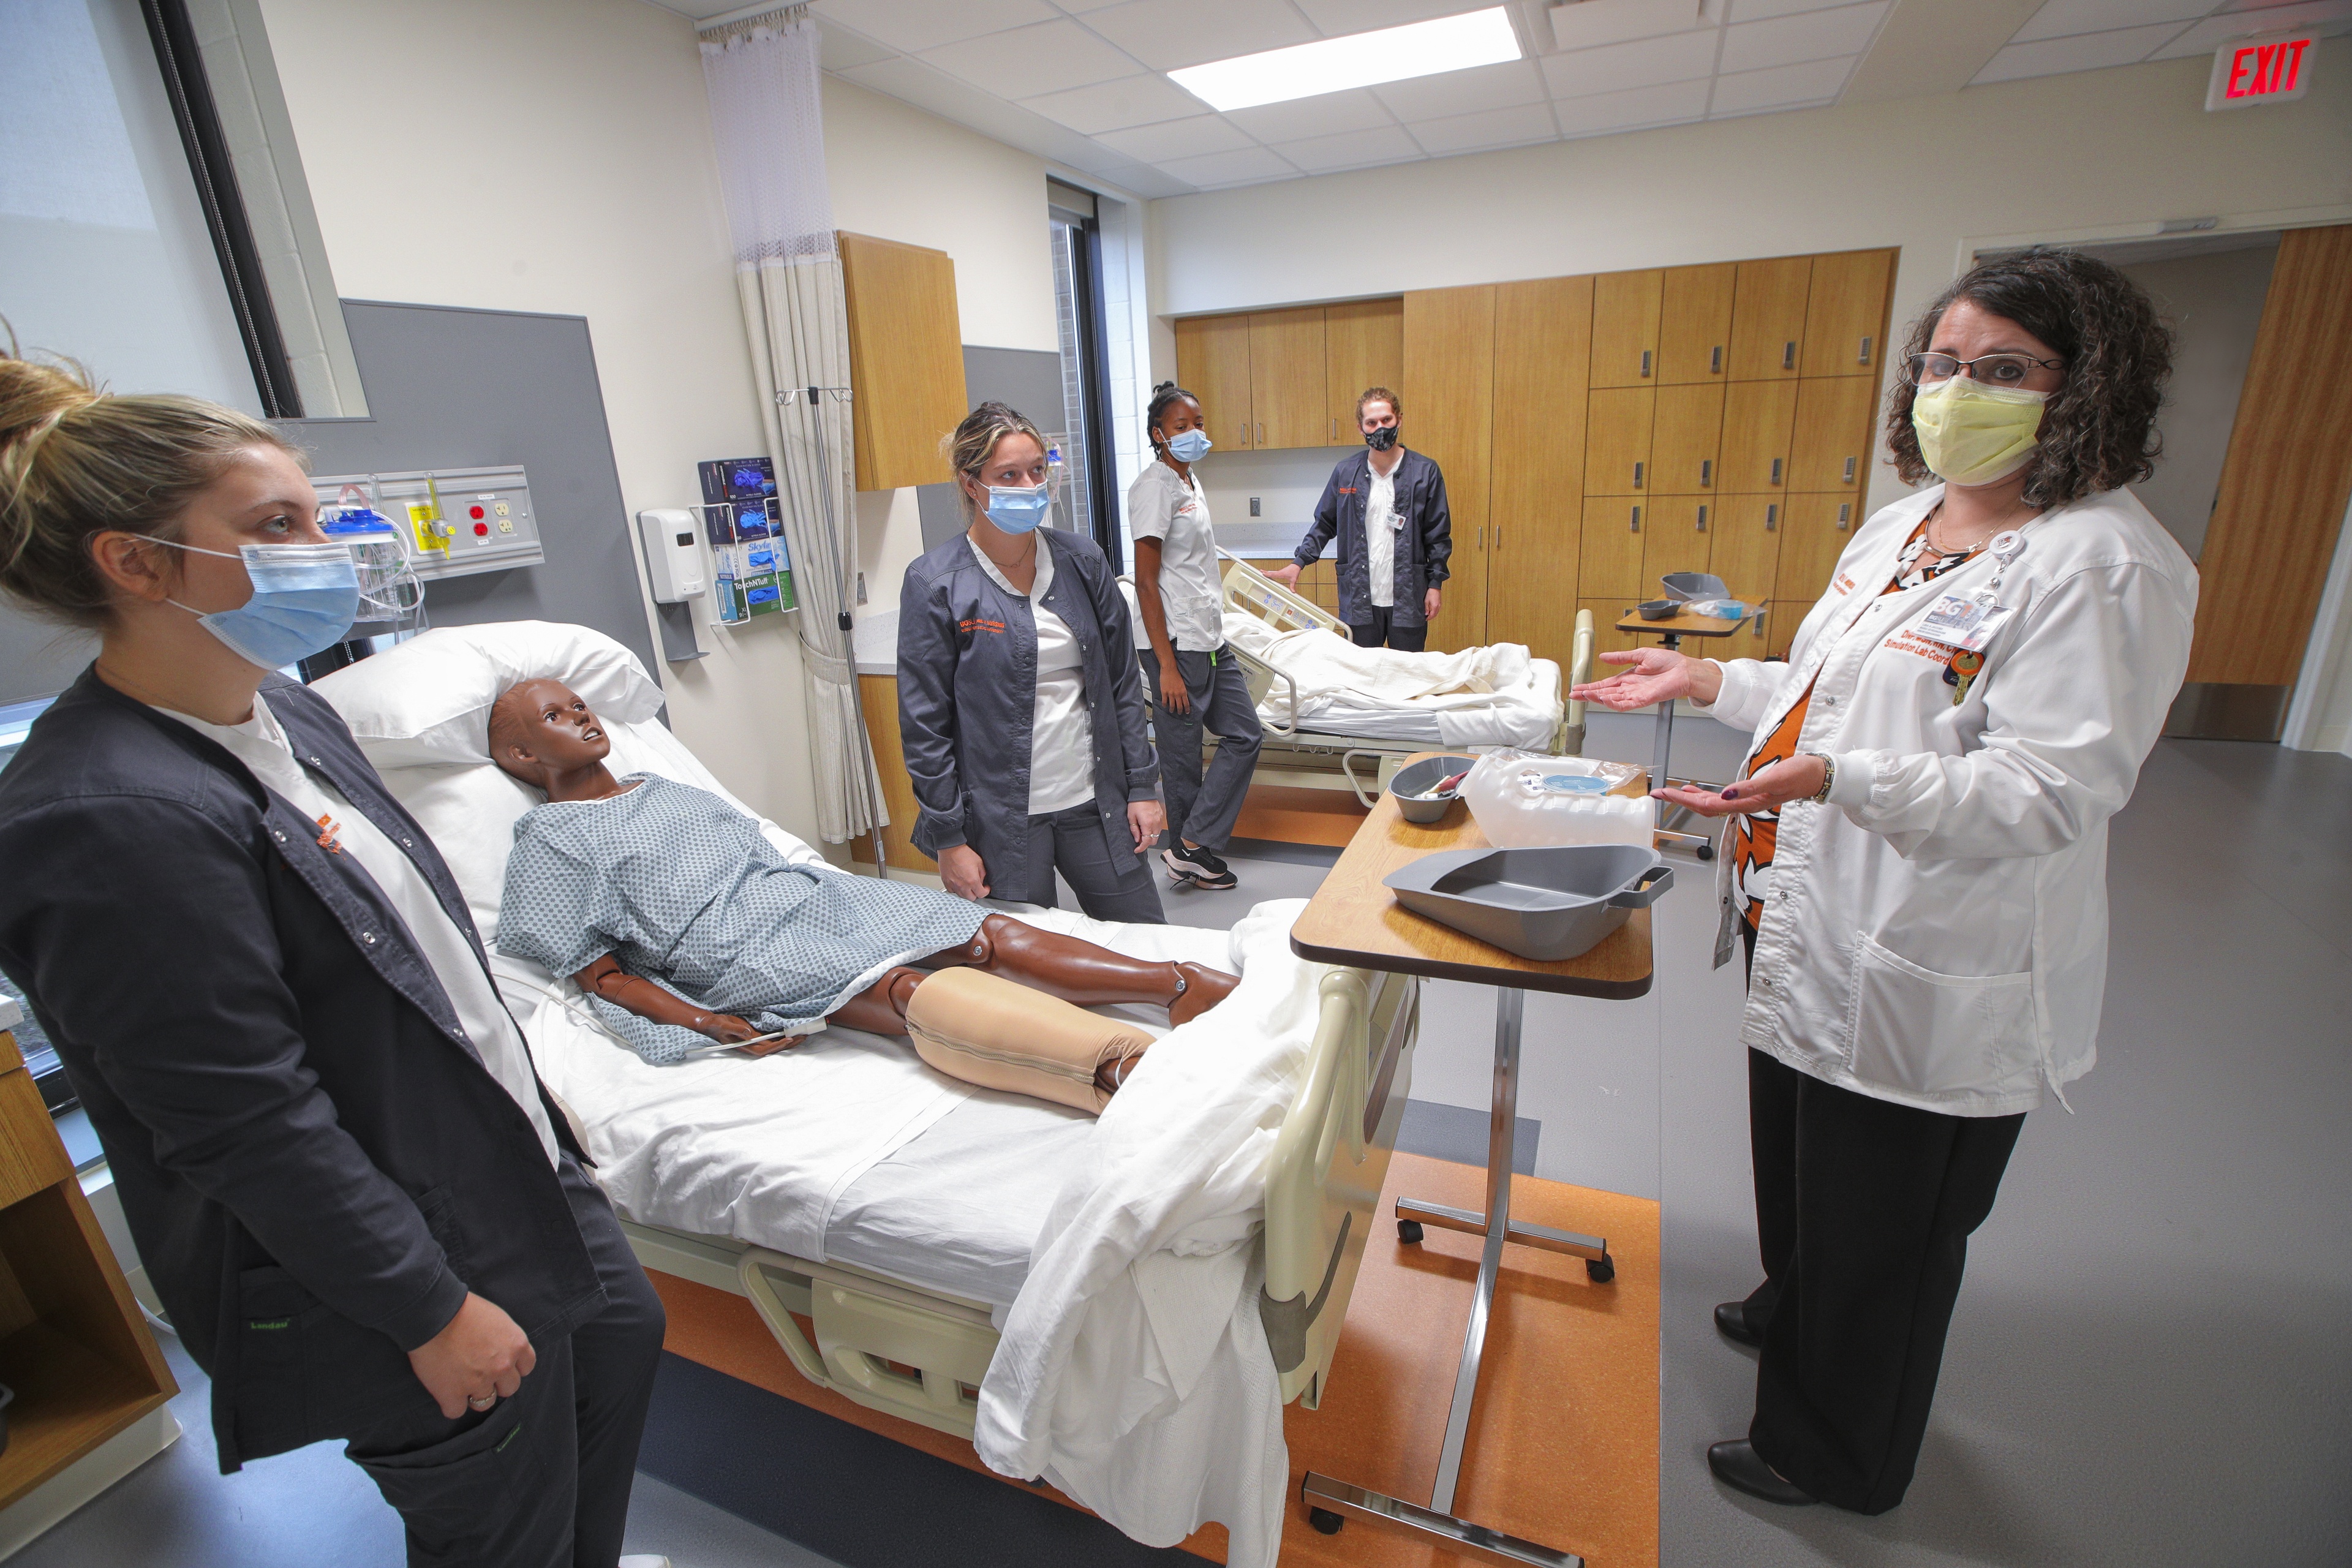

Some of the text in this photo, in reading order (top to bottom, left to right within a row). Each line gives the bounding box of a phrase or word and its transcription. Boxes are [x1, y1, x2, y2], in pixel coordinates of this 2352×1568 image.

[2226, 39, 2310, 99] EXIT
[734, 578, 768, 590] TochNTuff
[1884, 638, 1951, 665] Simulation Lab Coord
